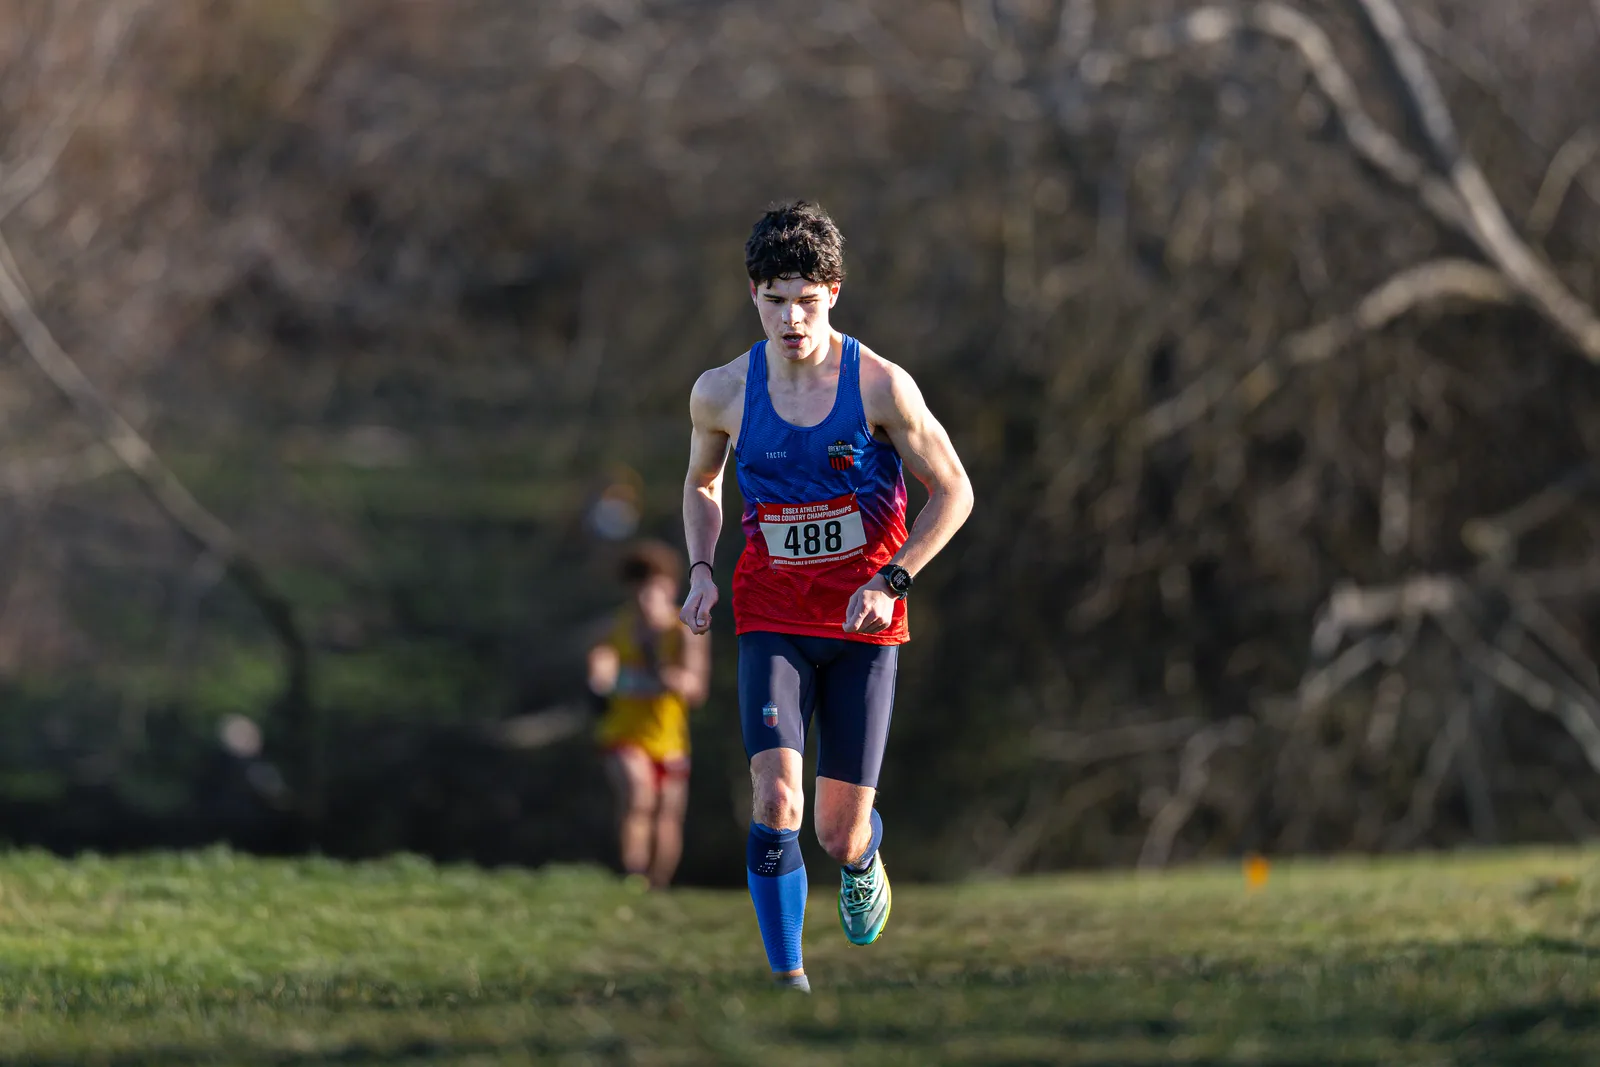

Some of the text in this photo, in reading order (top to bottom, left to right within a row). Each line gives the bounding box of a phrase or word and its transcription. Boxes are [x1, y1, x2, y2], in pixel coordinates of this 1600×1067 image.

[766, 451, 787, 459] TACTIC
[764, 505, 852, 522] CROSS COUNTRY CHAMPIONSHIPS
[782, 504, 829, 515] ESSEX ATHLETICS
[784, 520, 842, 556] 488
